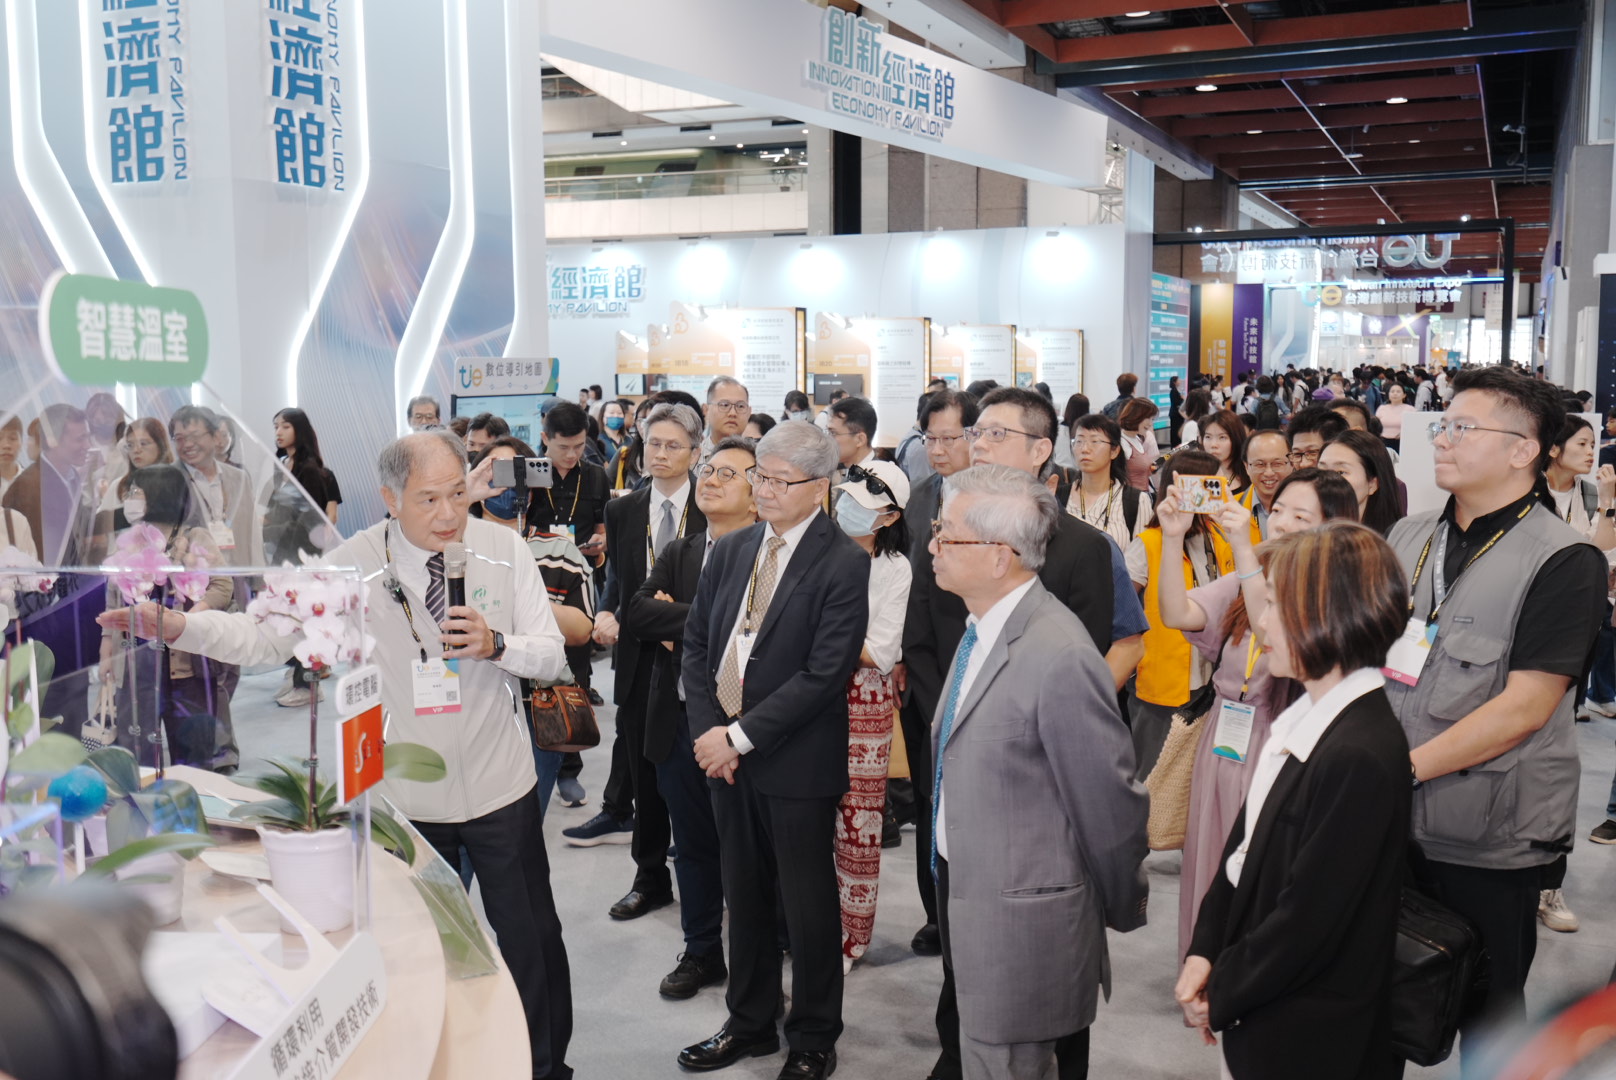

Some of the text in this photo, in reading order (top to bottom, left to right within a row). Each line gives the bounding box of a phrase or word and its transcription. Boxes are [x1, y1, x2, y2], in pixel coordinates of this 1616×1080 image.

[809, 60, 880, 99] INNOVATION
[828, 9, 955, 120] 創新經濟館
[103, 0, 165, 183] 濟館
[269, 0, 326, 188] 濟館
[832, 91, 944, 138] ECONOMY PAVILION
[169, 57, 187, 180] PAVILION
[330, 76, 344, 191] PAVILION
[551, 265, 642, 299] 經濟館
[76, 296, 189, 363] 智慧溫室
[567, 302, 627, 313] PAVILION
[459, 365, 482, 388] tie
[485, 362, 543, 377] 數位導引地圖
[1391, 671, 1402, 680] VIP
